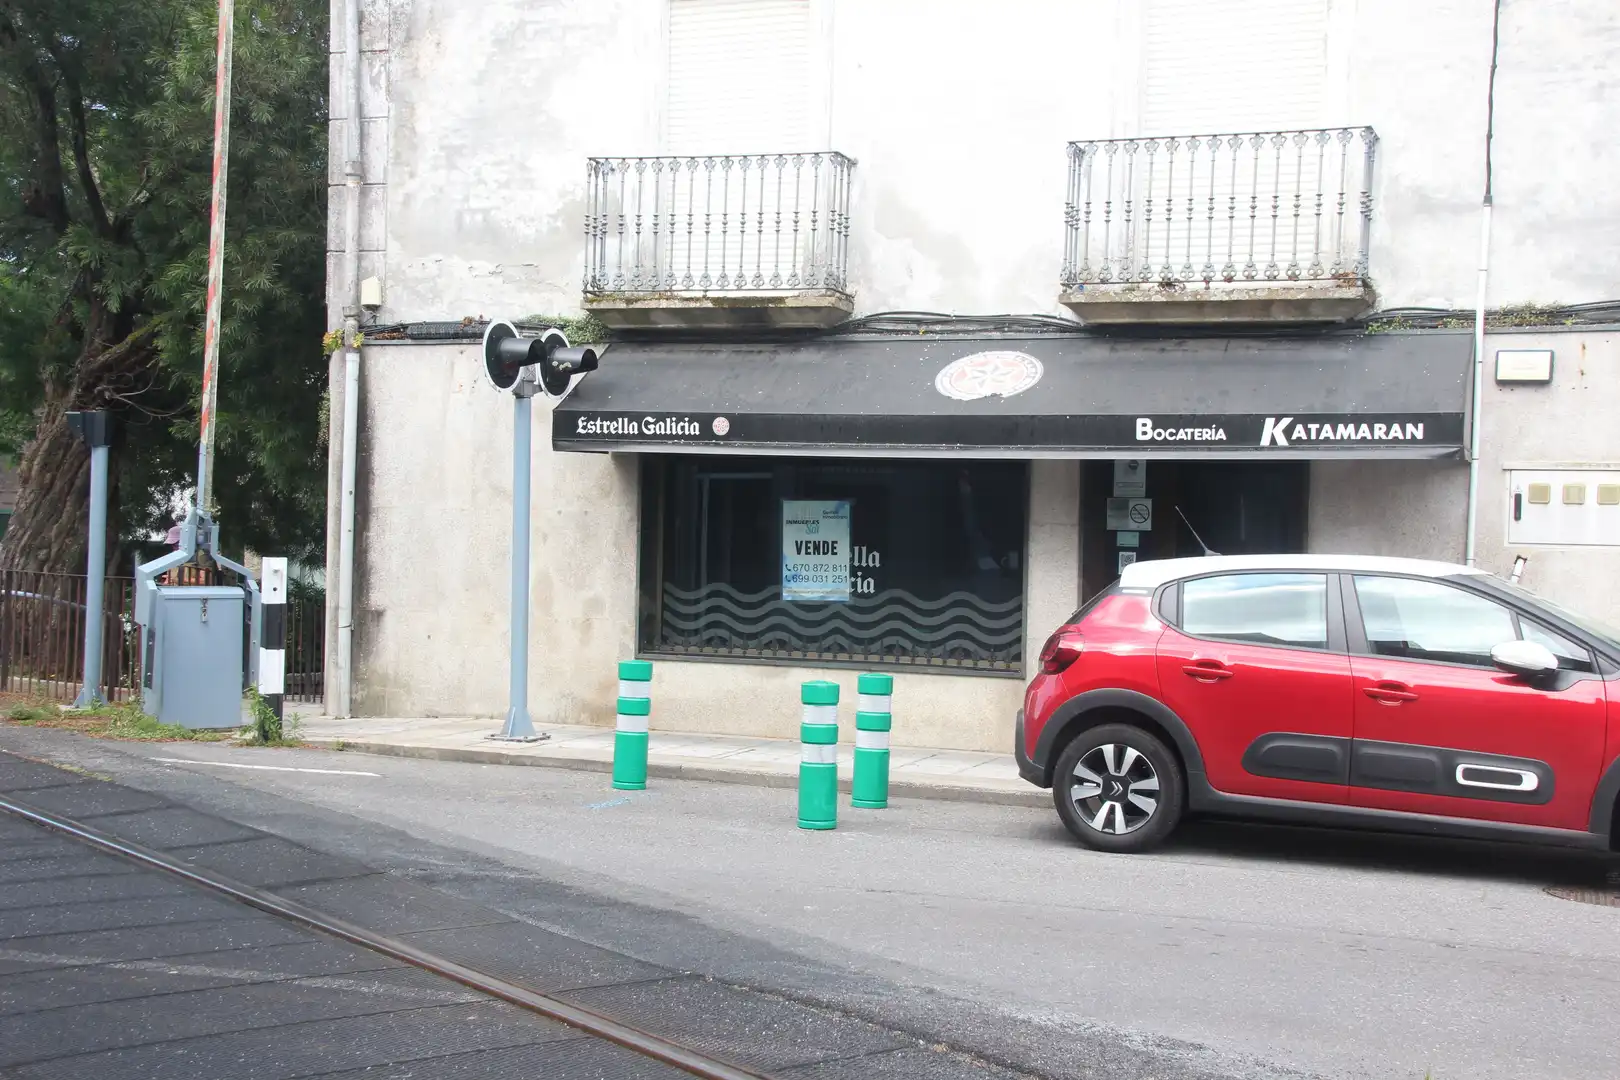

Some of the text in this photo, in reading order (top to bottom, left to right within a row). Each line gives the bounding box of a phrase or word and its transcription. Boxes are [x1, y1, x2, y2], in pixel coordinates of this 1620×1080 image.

[576, 416, 700, 436] Estrella Galicia
[1259, 417, 1425, 447] KATAMARAN
[795, 540, 838, 556] VENDE
[793, 563, 848, 573] 670 872 811
[792, 574, 848, 584] 699 031 251
